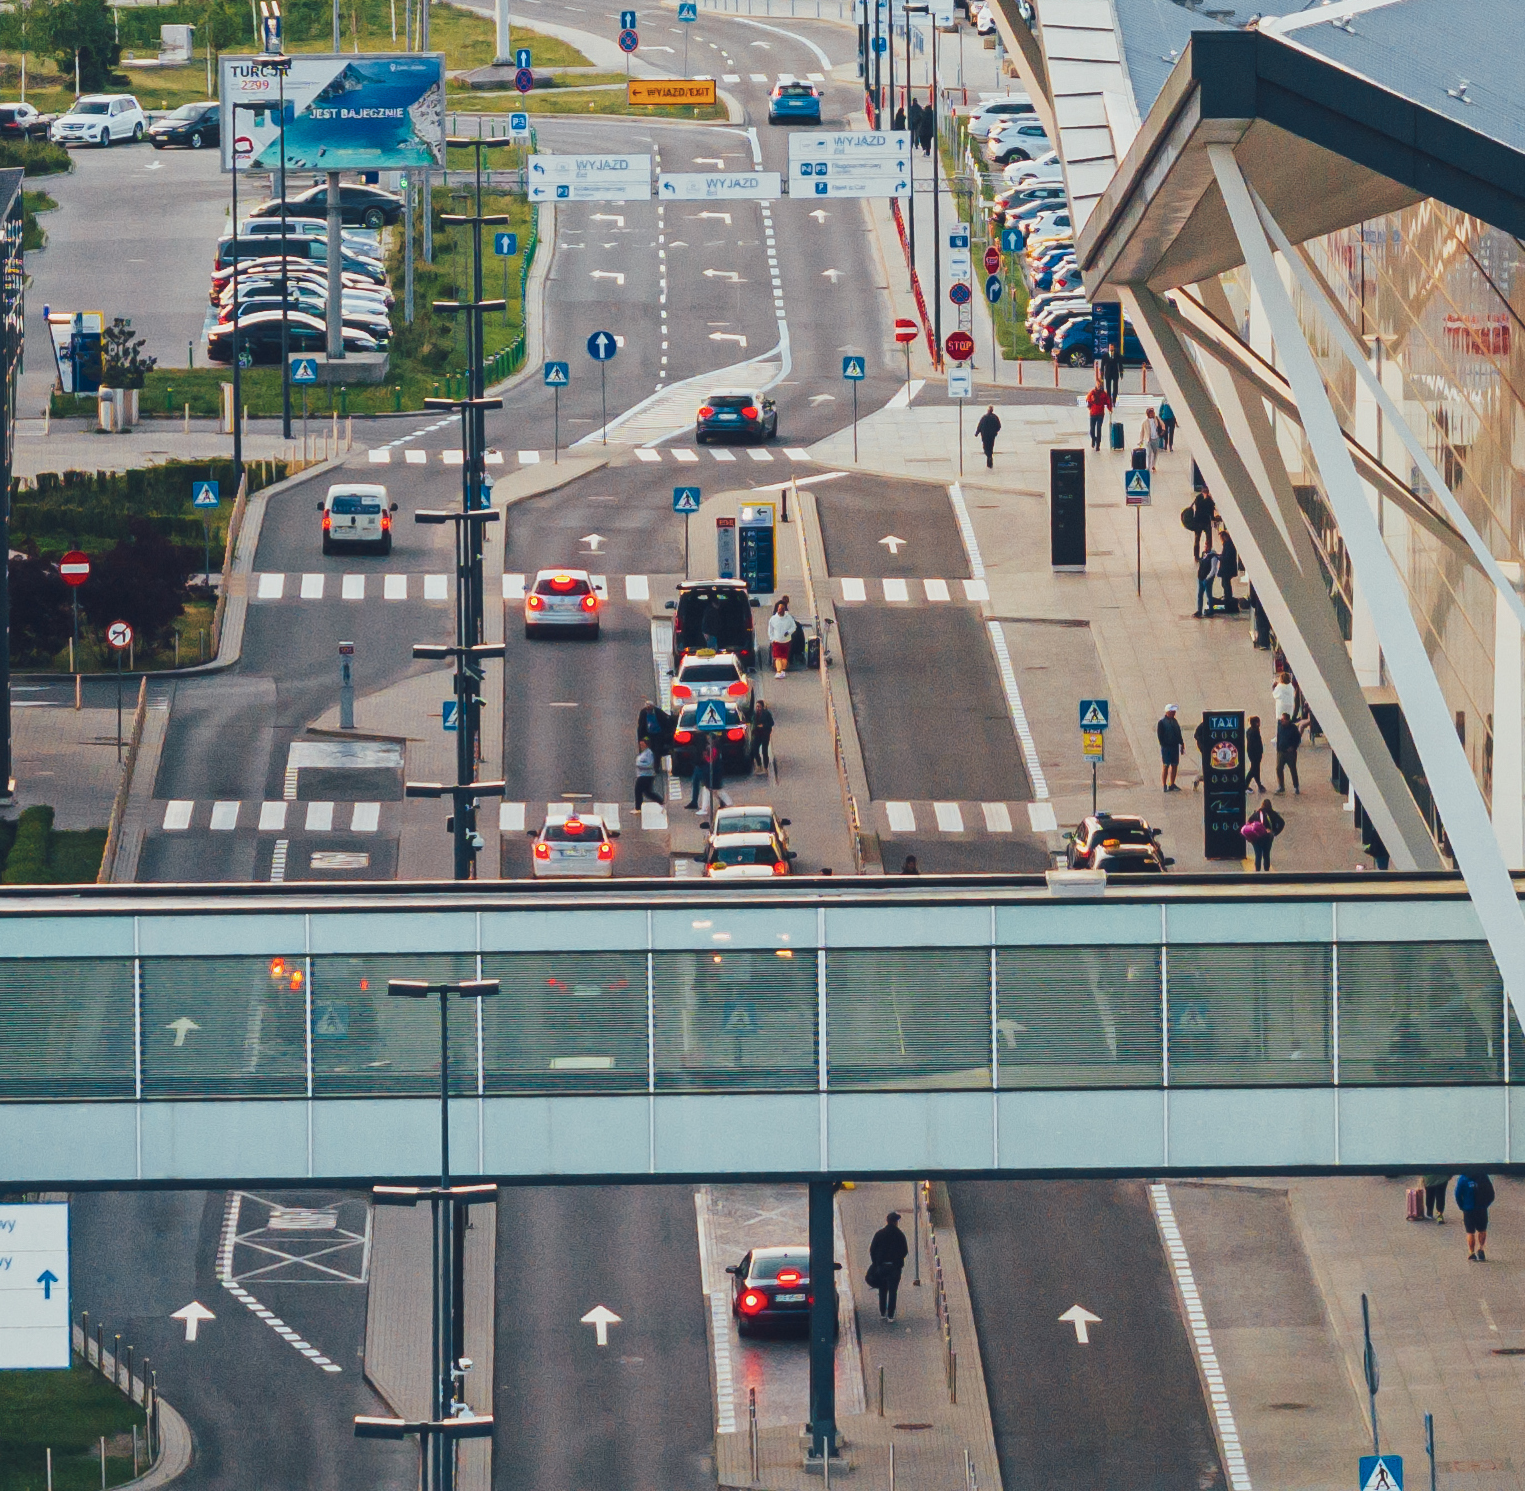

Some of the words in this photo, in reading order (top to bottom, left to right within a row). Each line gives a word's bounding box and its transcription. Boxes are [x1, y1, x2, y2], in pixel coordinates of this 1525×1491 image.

[309, 109, 337, 119] JEST
[341, 108, 404, 119] BAJECZNIE
[834, 135, 886, 146] WYJAZD
[576, 160, 629, 170] WYJAZD
[706, 178, 759, 189] WYJAZD
[949, 341, 972, 351] STOP
[1211, 718, 1237, 727] TAXI
